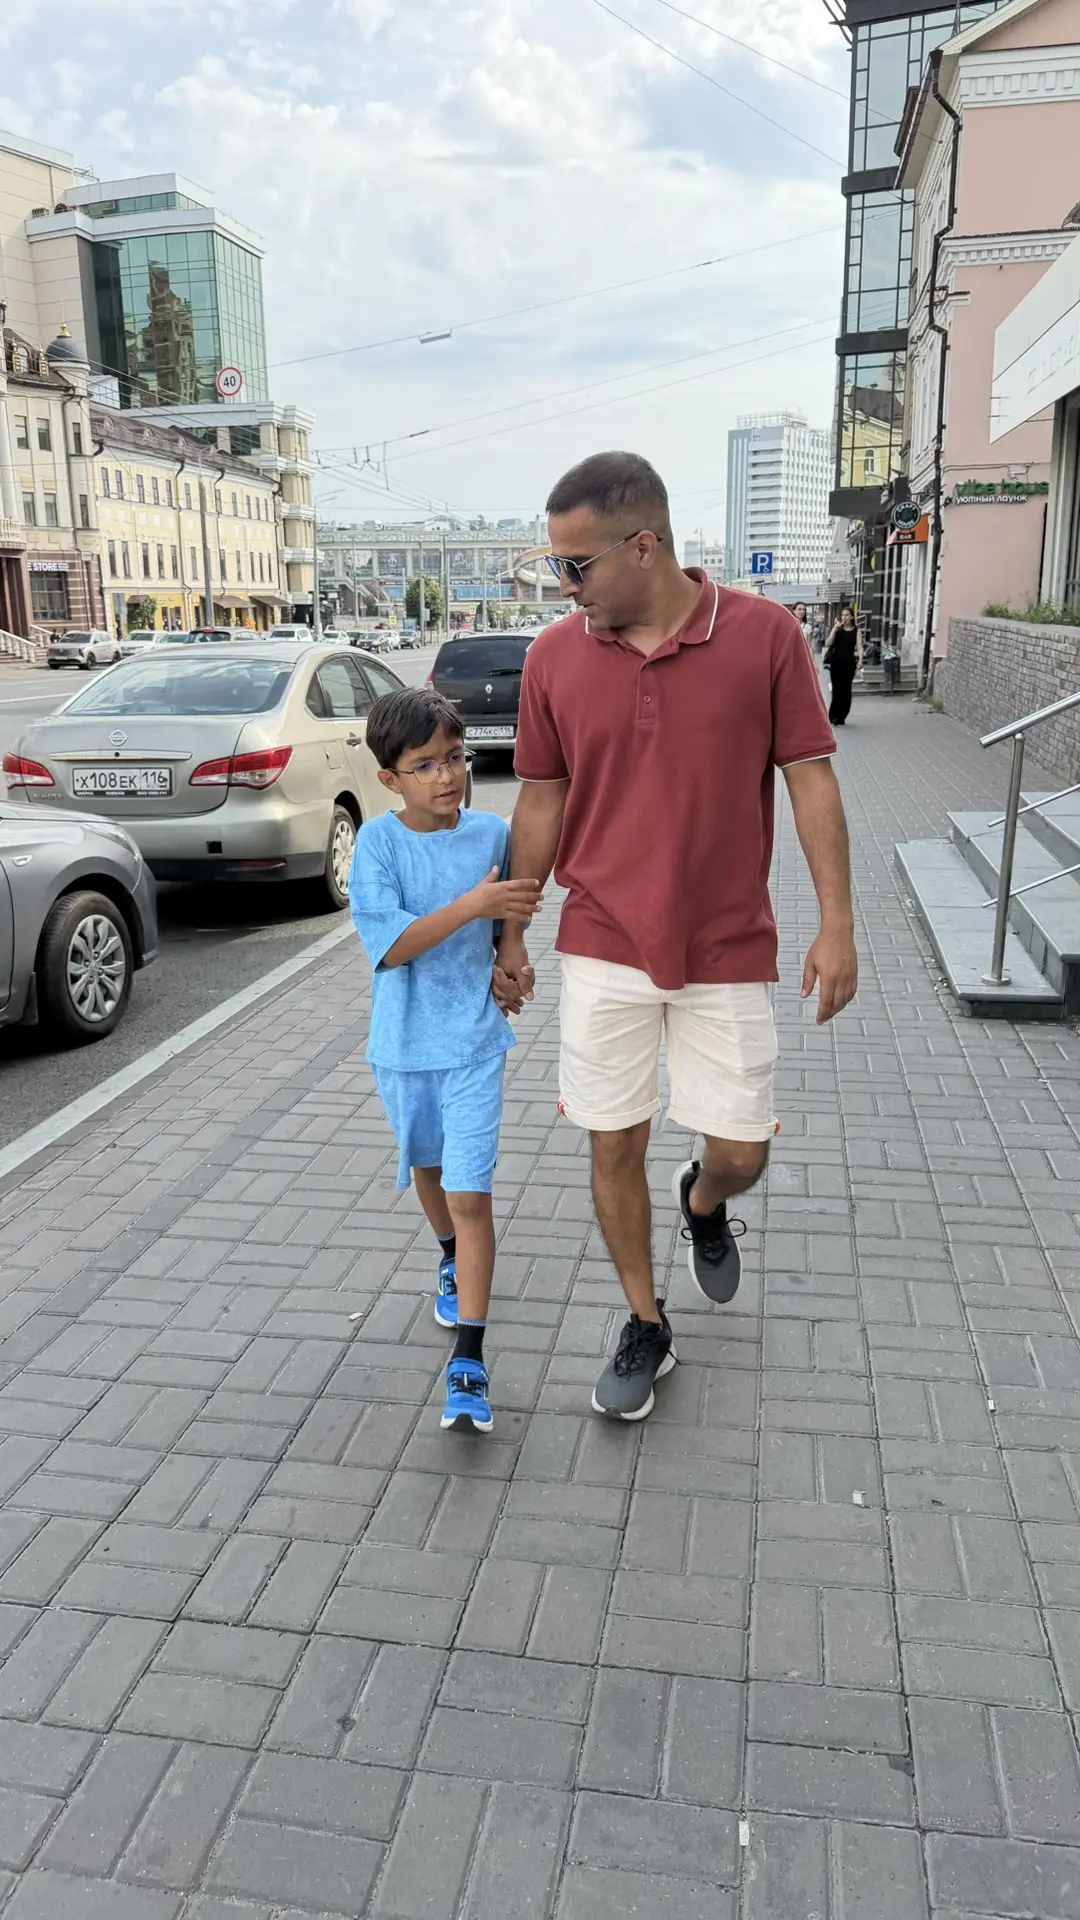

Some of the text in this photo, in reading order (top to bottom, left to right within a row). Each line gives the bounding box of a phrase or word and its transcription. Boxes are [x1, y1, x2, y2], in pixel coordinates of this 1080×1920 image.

[223, 375, 236, 388] 40
[1001, 479, 1050, 495] hous
[956, 493, 1028, 504] уютный лаунж
[33, 562, 59, 571] STORE
[756, 554, 769, 573] P
[142, 771, 166, 784] 116
